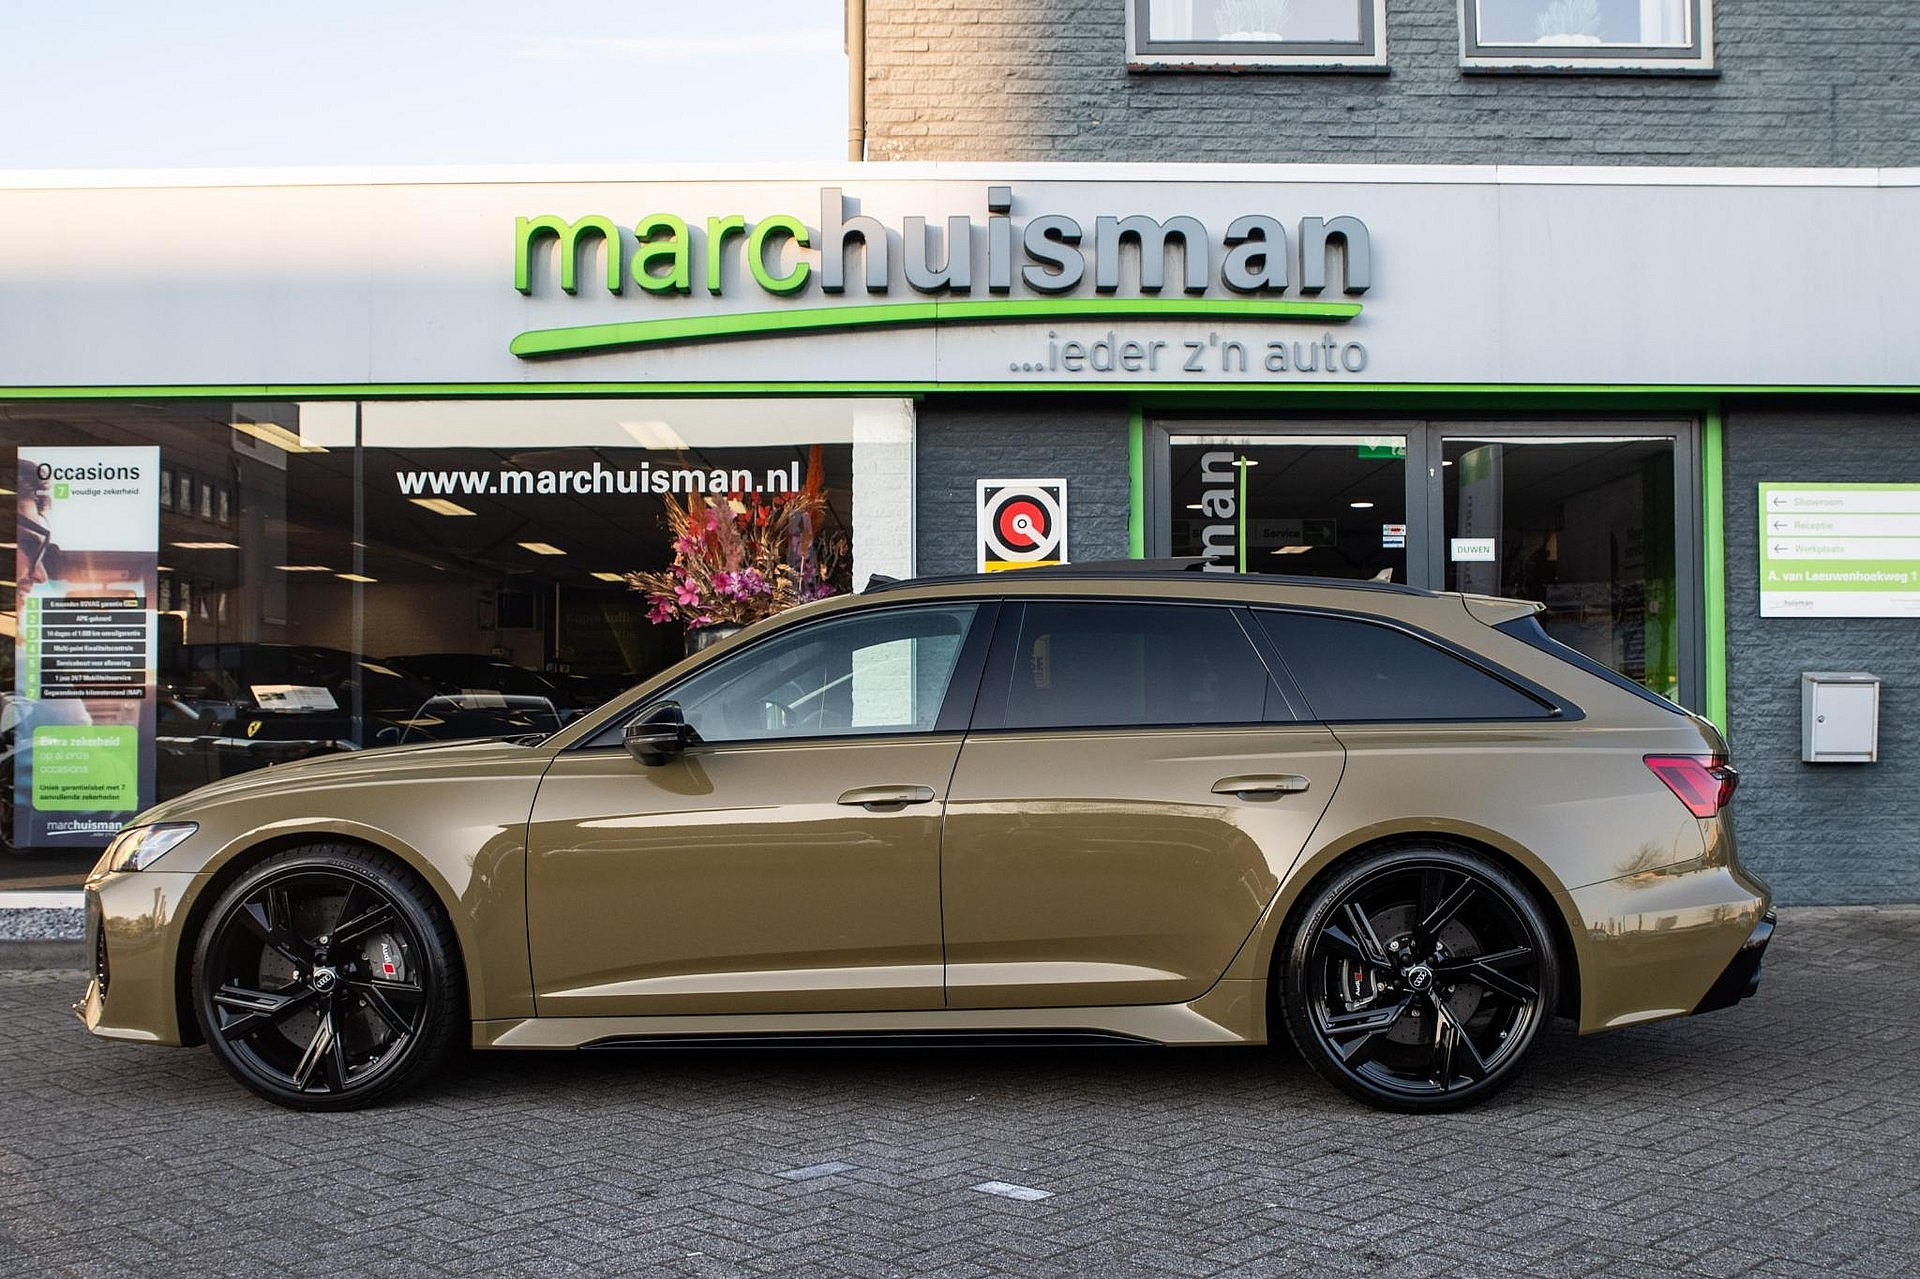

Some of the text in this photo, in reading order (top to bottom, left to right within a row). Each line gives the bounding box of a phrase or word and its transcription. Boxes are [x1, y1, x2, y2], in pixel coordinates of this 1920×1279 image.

[515, 186, 1371, 297] marchuisman
[1184, 332, 1246, 373] z'n
[1264, 331, 1368, 373] auto
[37, 462, 140, 480] Occasions
[396, 461, 800, 495] www.marchuisman.nl
[57, 486, 65, 496] 7
[1457, 545, 1490, 553] DUWEN
[1767, 570, 1780, 581] A.
[1783, 572, 1803, 581] van
[47, 819, 122, 830] marchuisman
